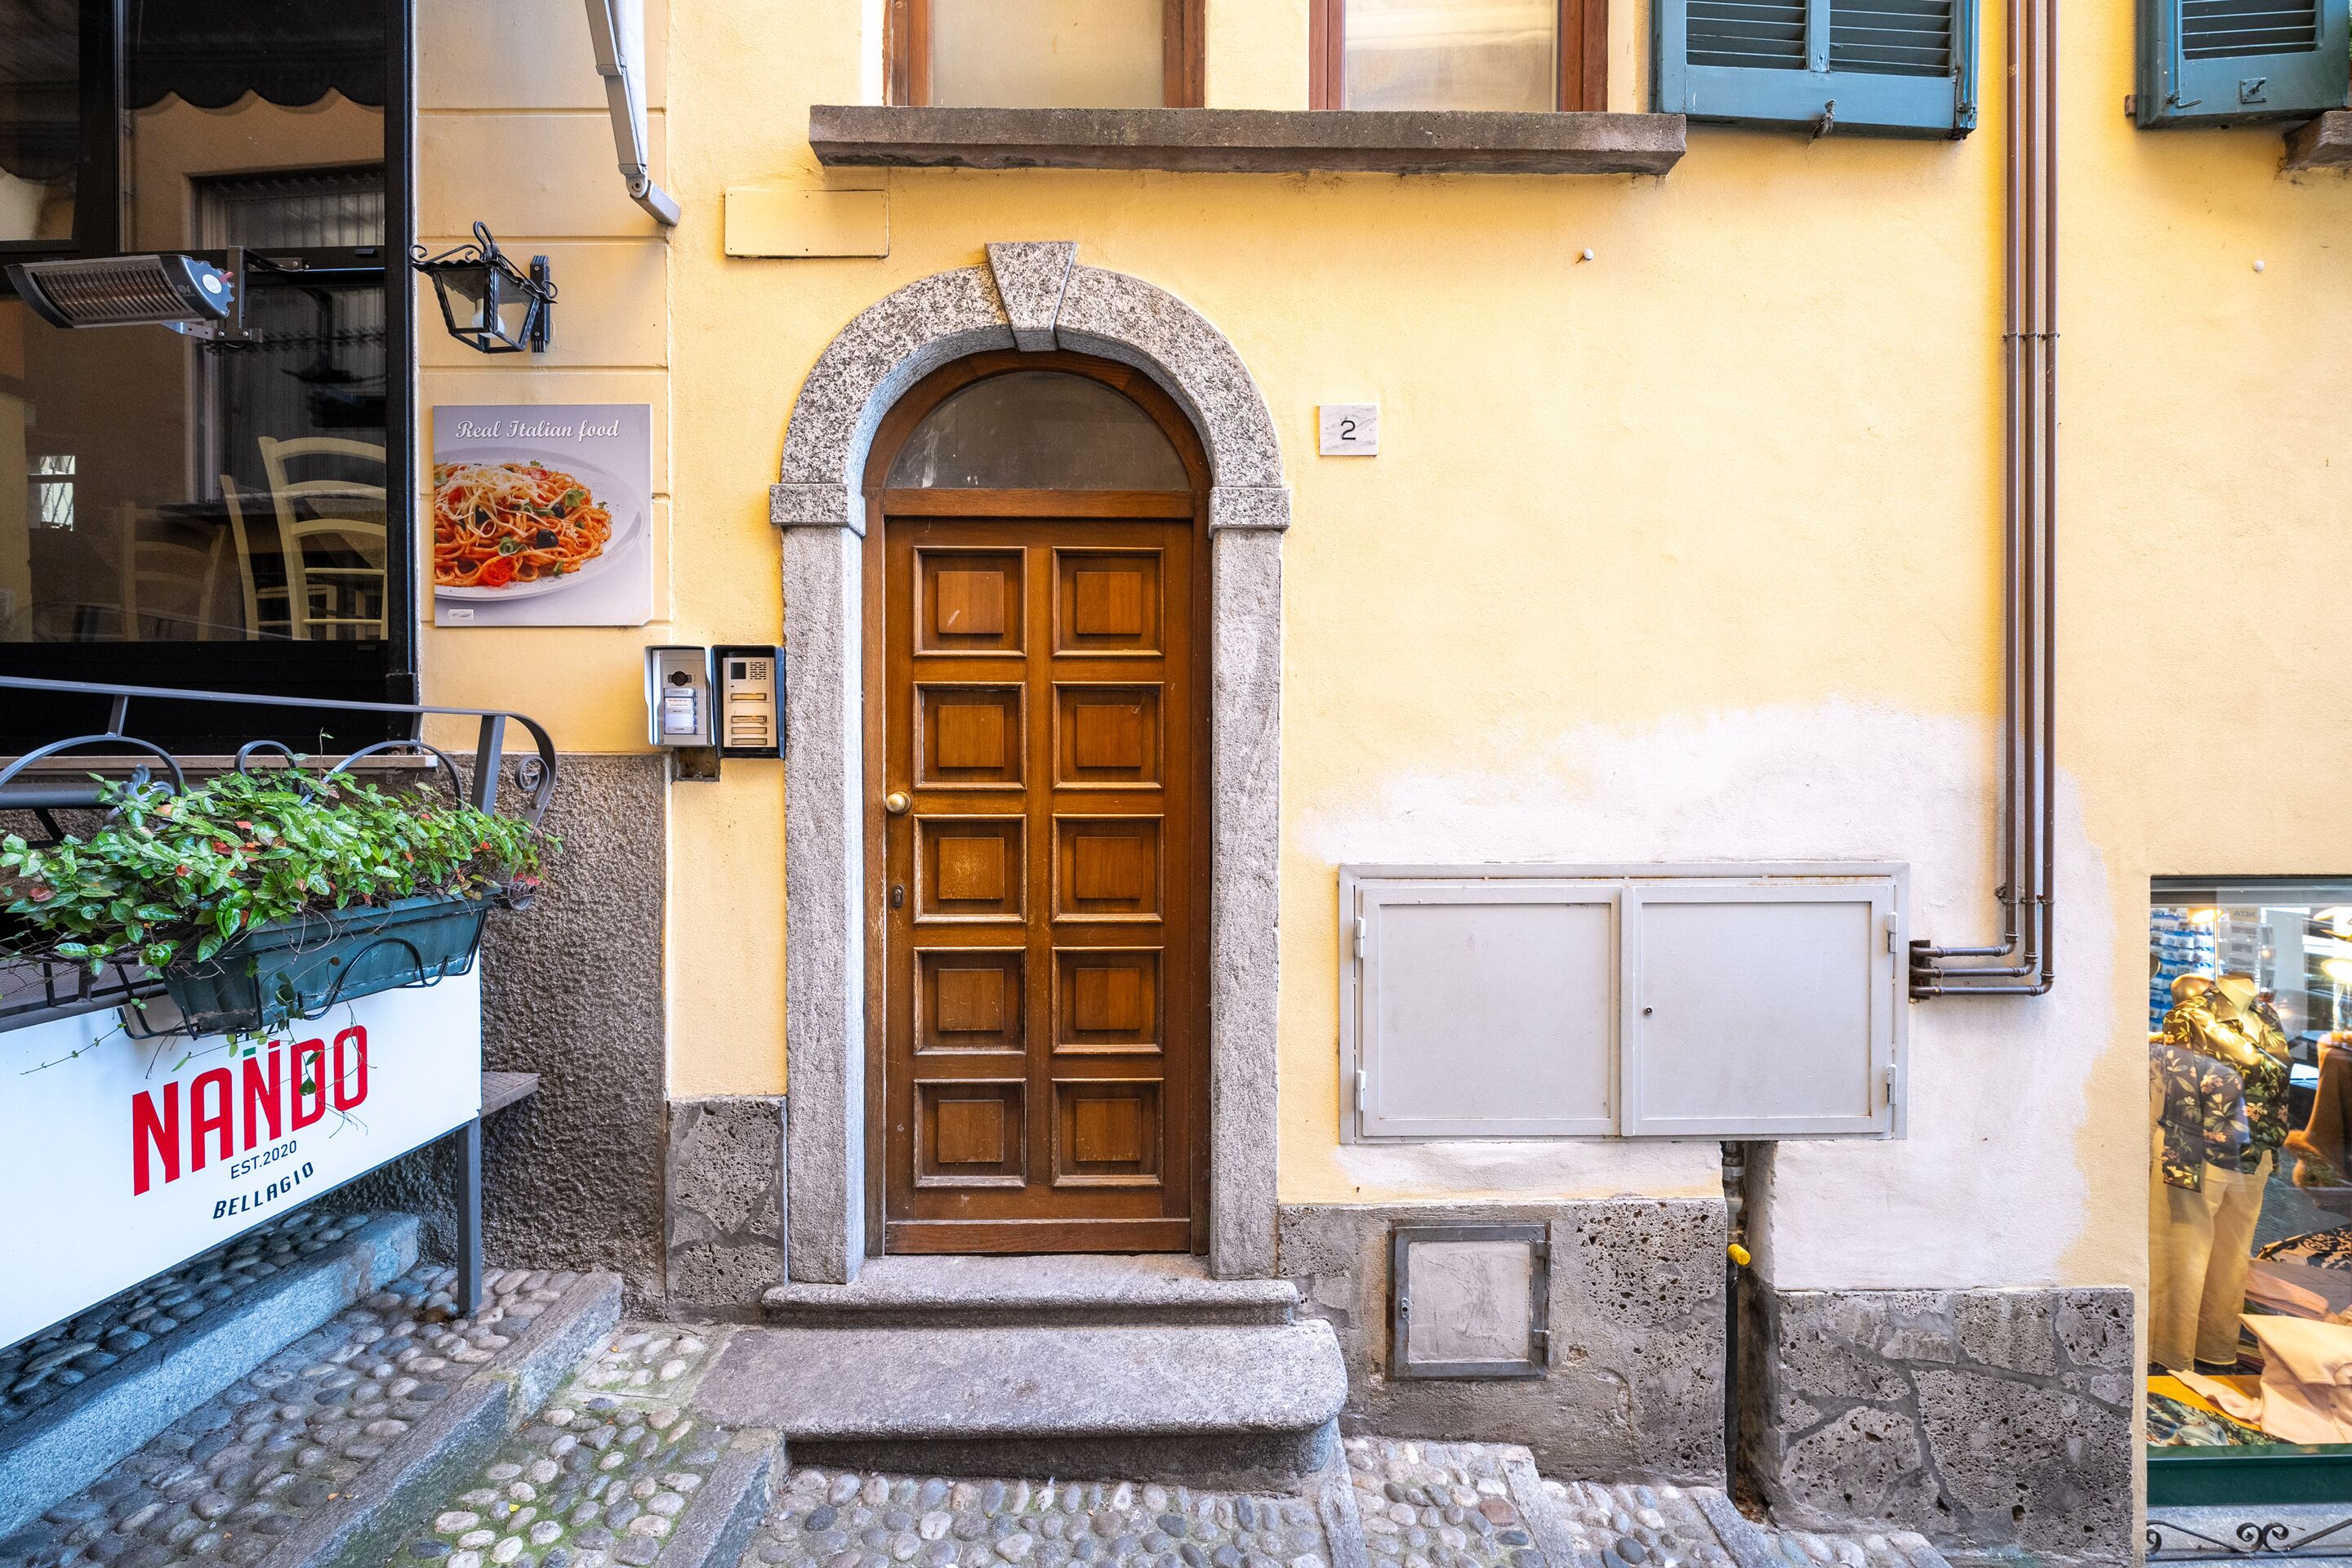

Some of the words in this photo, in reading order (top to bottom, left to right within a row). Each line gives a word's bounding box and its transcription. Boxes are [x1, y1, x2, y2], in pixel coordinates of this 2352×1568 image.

[456, 421, 501, 438] Real
[506, 420, 573, 438] Italian
[578, 419, 621, 443] food
[1340, 420, 1356, 440] 2
[132, 1025, 368, 1196] NANDO
[230, 1140, 297, 1179] EST.2020
[212, 1161, 314, 1219] BELLAGIO
